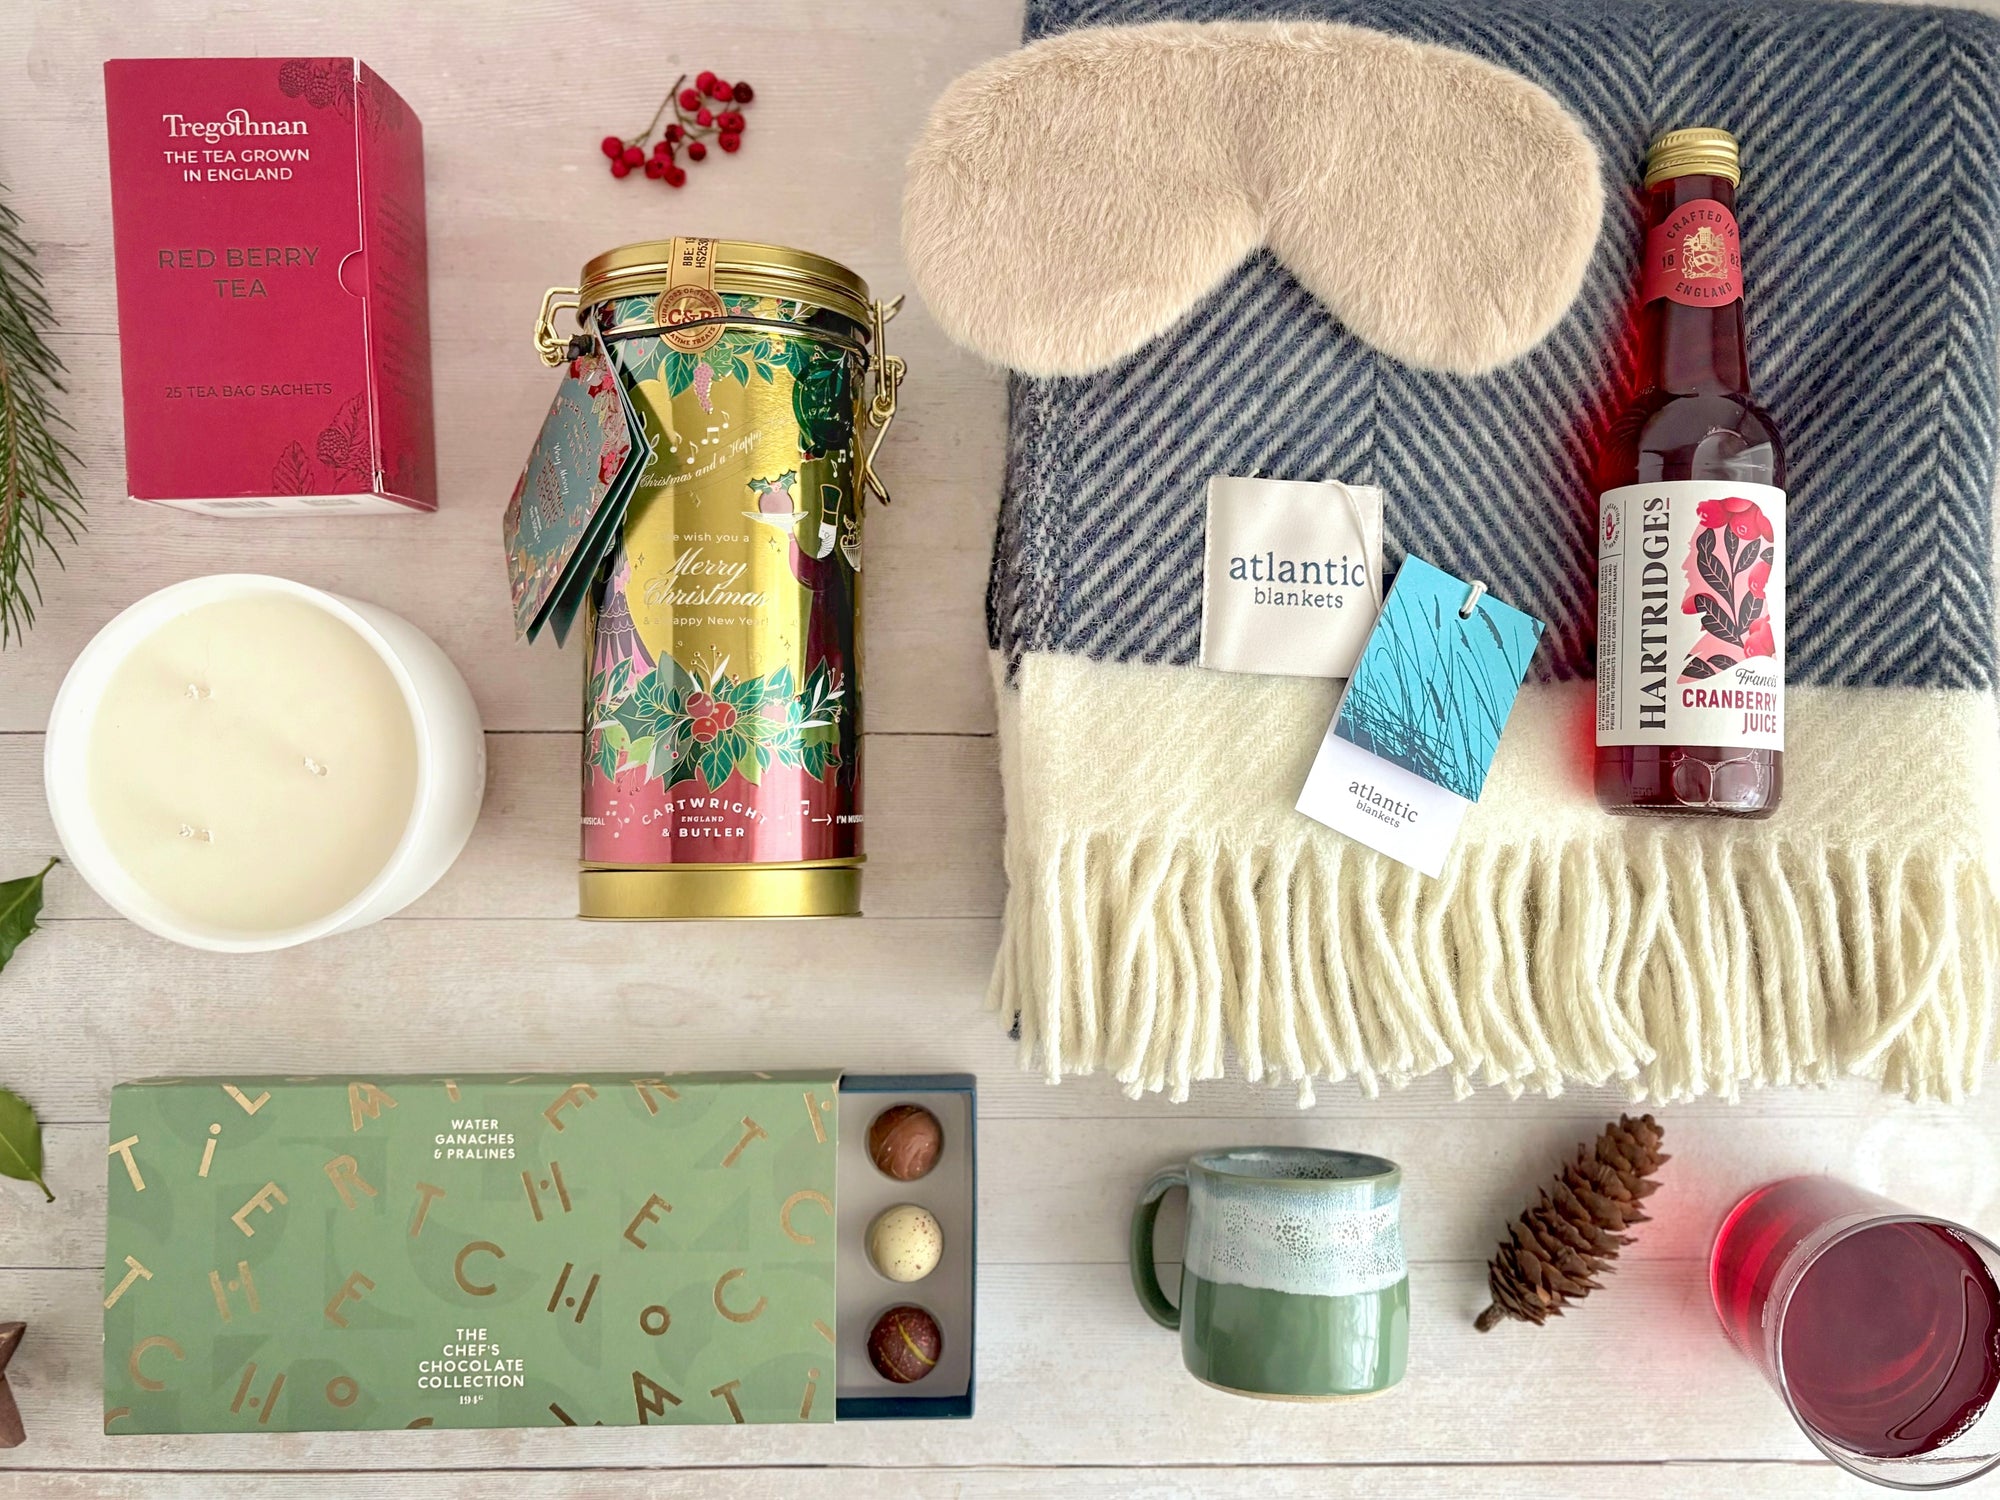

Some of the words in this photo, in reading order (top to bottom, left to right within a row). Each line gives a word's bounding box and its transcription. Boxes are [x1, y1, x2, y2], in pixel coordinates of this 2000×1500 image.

[162, 108, 309, 144] Tregothnan
[163, 151, 198, 164] THE
[202, 150, 236, 163] TEA
[240, 149, 310, 163] GROWN
[183, 169, 201, 182] IN
[207, 168, 293, 182] ENGLAND
[1666, 210, 1722, 239] CRAFTED
[1724, 223, 1735, 238] IN
[159, 250, 215, 269] RED
[227, 247, 319, 268] BERRY
[1662, 254, 1674, 268] 18
[213, 279, 268, 298] TEA
[1675, 281, 1733, 298] ENGLAND
[662, 289, 682, 323] CURATORS
[691, 326, 716, 345] TREATS
[165, 386, 182, 399] 25
[187, 386, 218, 398] TEA
[223, 385, 256, 398] BAG
[260, 383, 333, 397] SACHETS
[639, 472, 692, 488] Christmas
[695, 453, 716, 476] and
[719, 456, 726, 465] a
[684, 532, 711, 542] wish
[715, 535, 738, 544] you
[663, 547, 748, 587] Merry
[1228, 551, 1366, 588] atlantic
[644, 576, 768, 609] Christmas
[1253, 586, 1344, 609] blankets
[665, 617, 703, 627] appy
[707, 616, 735, 625] New
[1639, 497, 1670, 730] HARTRIDGES
[1735, 668, 1778, 688] Francis
[1682, 688, 1777, 712] CRANBERRY
[1742, 712, 1777, 735] JUICE
[641, 797, 769, 825] CARTWRIGHT
[1348, 781, 1419, 823] atlantic
[681, 815, 725, 823] ENGLAND
[1356, 799, 1401, 828] blankets
[661, 828, 671, 838] &
[679, 827, 745, 838] BUTLER
[451, 1119, 499, 1130] WATER
[435, 1133, 515, 1145] GANACHES
[434, 1148, 442, 1160] &
[447, 1148, 516, 1160] PRALINES
[456, 1328, 488, 1341] THE
[443, 1344, 500, 1357] CHEF'S
[419, 1359, 524, 1373] CHOCOLATE
[418, 1375, 524, 1389] COLLECTION
